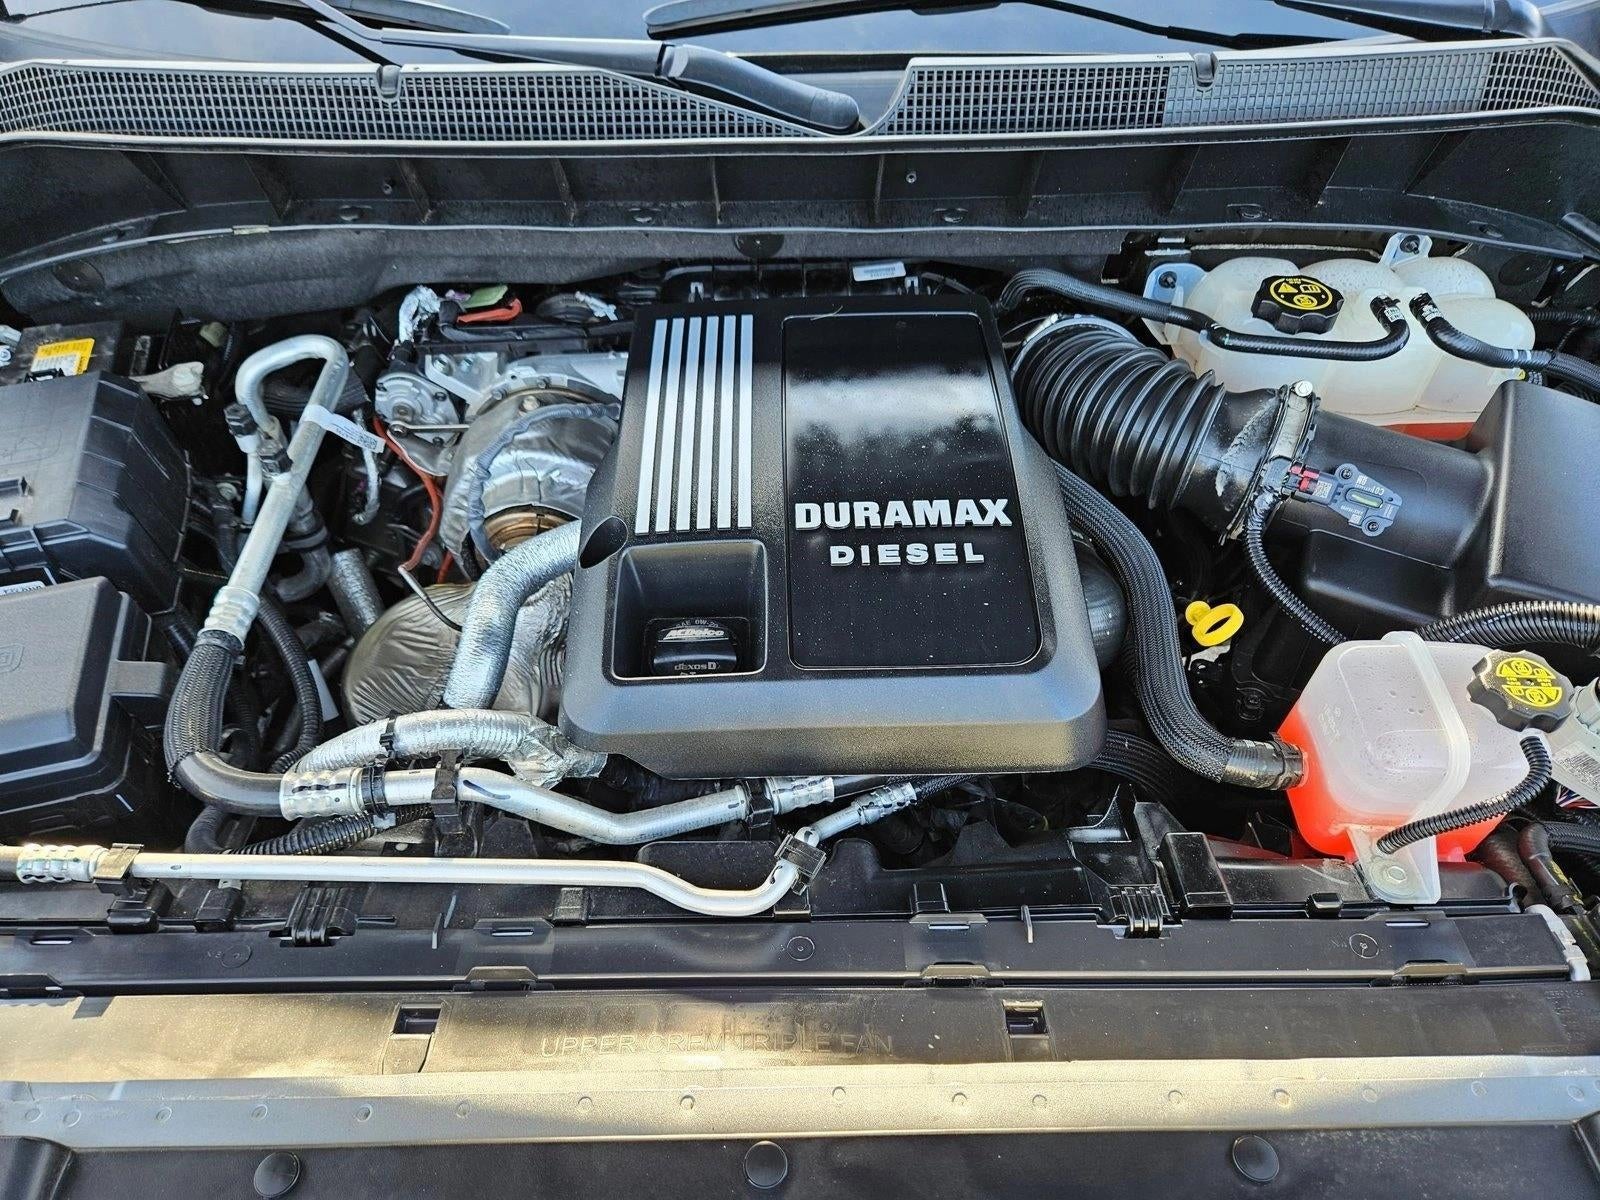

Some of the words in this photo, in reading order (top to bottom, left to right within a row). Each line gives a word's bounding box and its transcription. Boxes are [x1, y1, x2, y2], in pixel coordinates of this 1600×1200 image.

[795, 499, 1013, 531] DURAMAX
[829, 542, 985, 567] DIESEL
[541, 1034, 637, 1058] UPPER
[736, 1031, 832, 1053] TRIPLE
[840, 1033, 894, 1057] FAN
